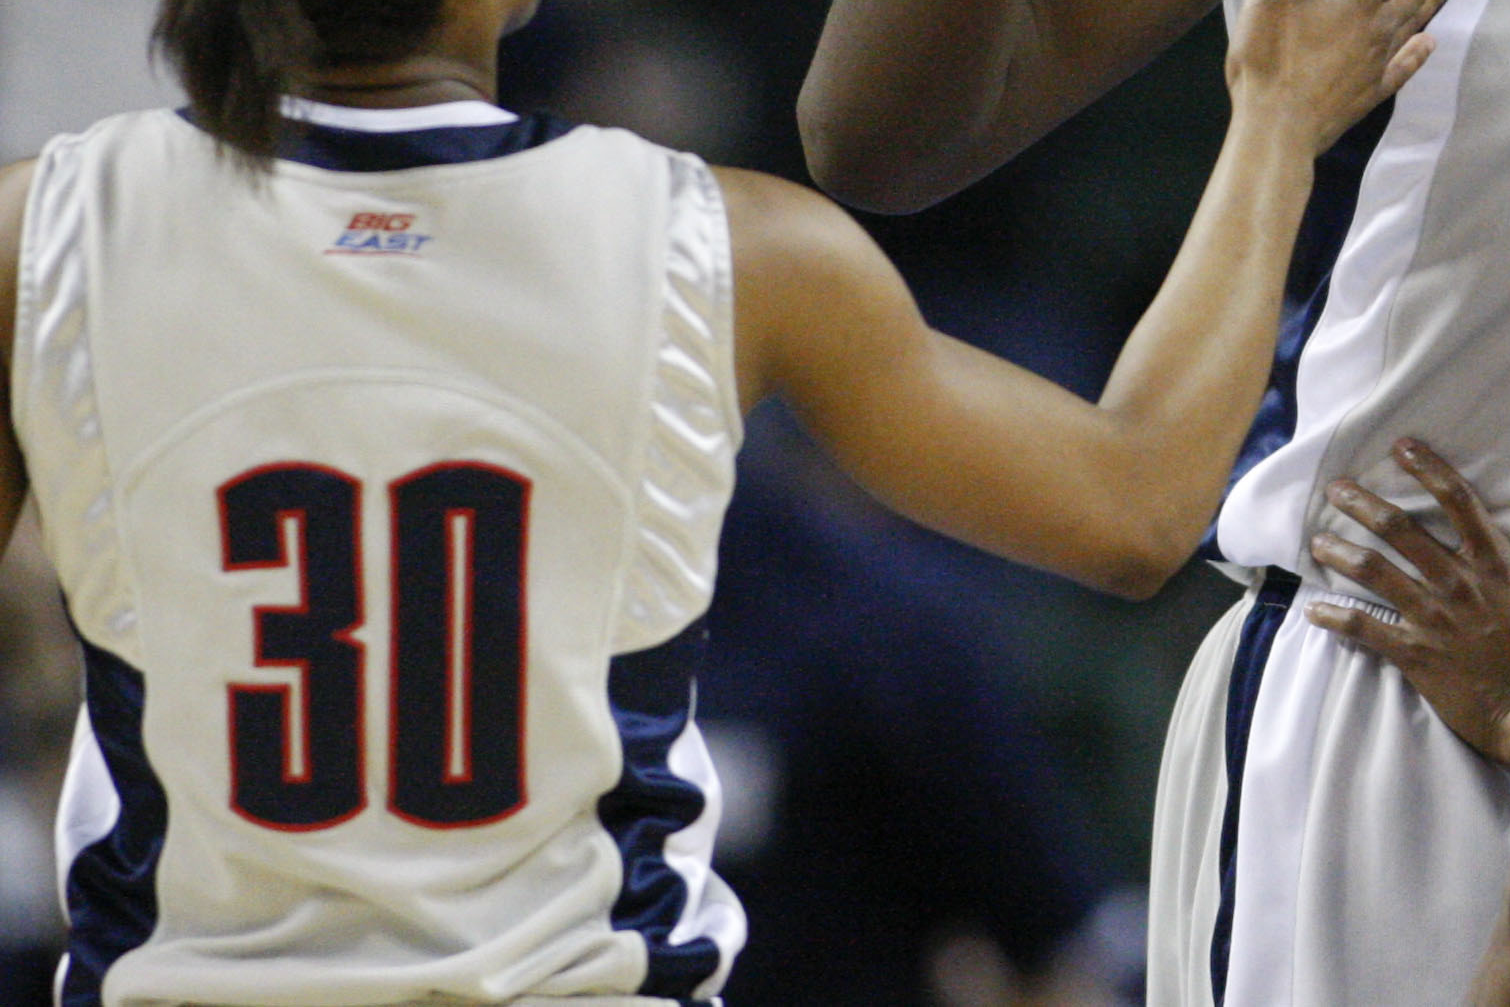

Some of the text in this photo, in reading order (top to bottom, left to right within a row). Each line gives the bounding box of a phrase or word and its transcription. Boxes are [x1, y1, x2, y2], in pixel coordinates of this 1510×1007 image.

[346, 212, 417, 231] BIG
[335, 233, 435, 251] EAST
[215, 459, 533, 833] 30
